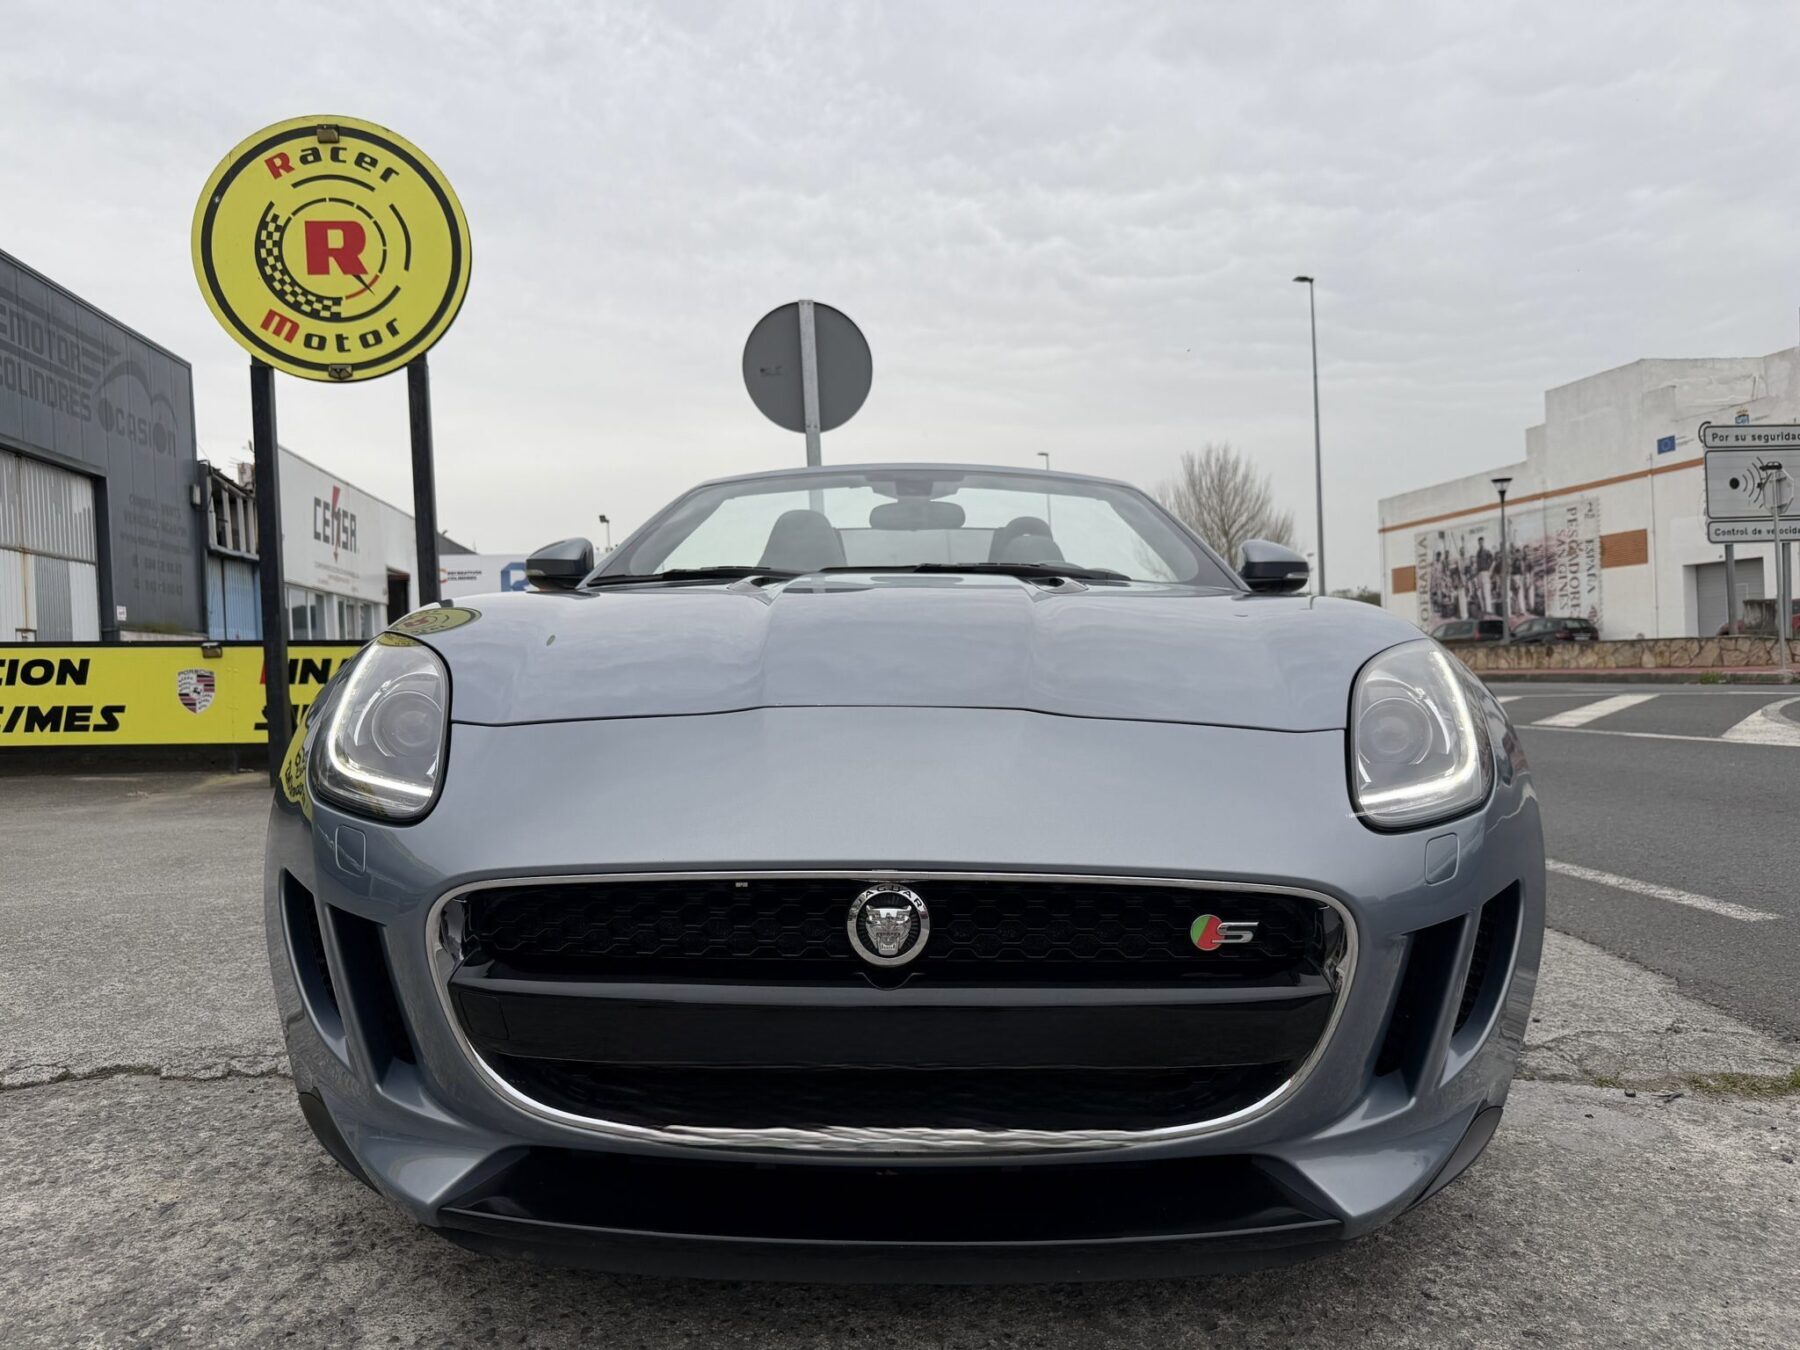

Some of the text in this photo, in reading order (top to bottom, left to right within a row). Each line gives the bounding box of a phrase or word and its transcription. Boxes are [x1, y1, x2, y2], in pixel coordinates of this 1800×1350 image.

[264, 146, 400, 183] Racer
[304, 220, 369, 275] R
[260, 308, 400, 353] Motor
[0, 354, 92, 422] OLINDRES
[1711, 432, 1729, 442] Por
[1735, 433, 1747, 442] su
[1714, 525, 1800, 537] Control de veocid
[1418, 536, 1430, 632] OFRADIA
[0, 658, 91, 686] ION
[0, 705, 126, 732] /MES
